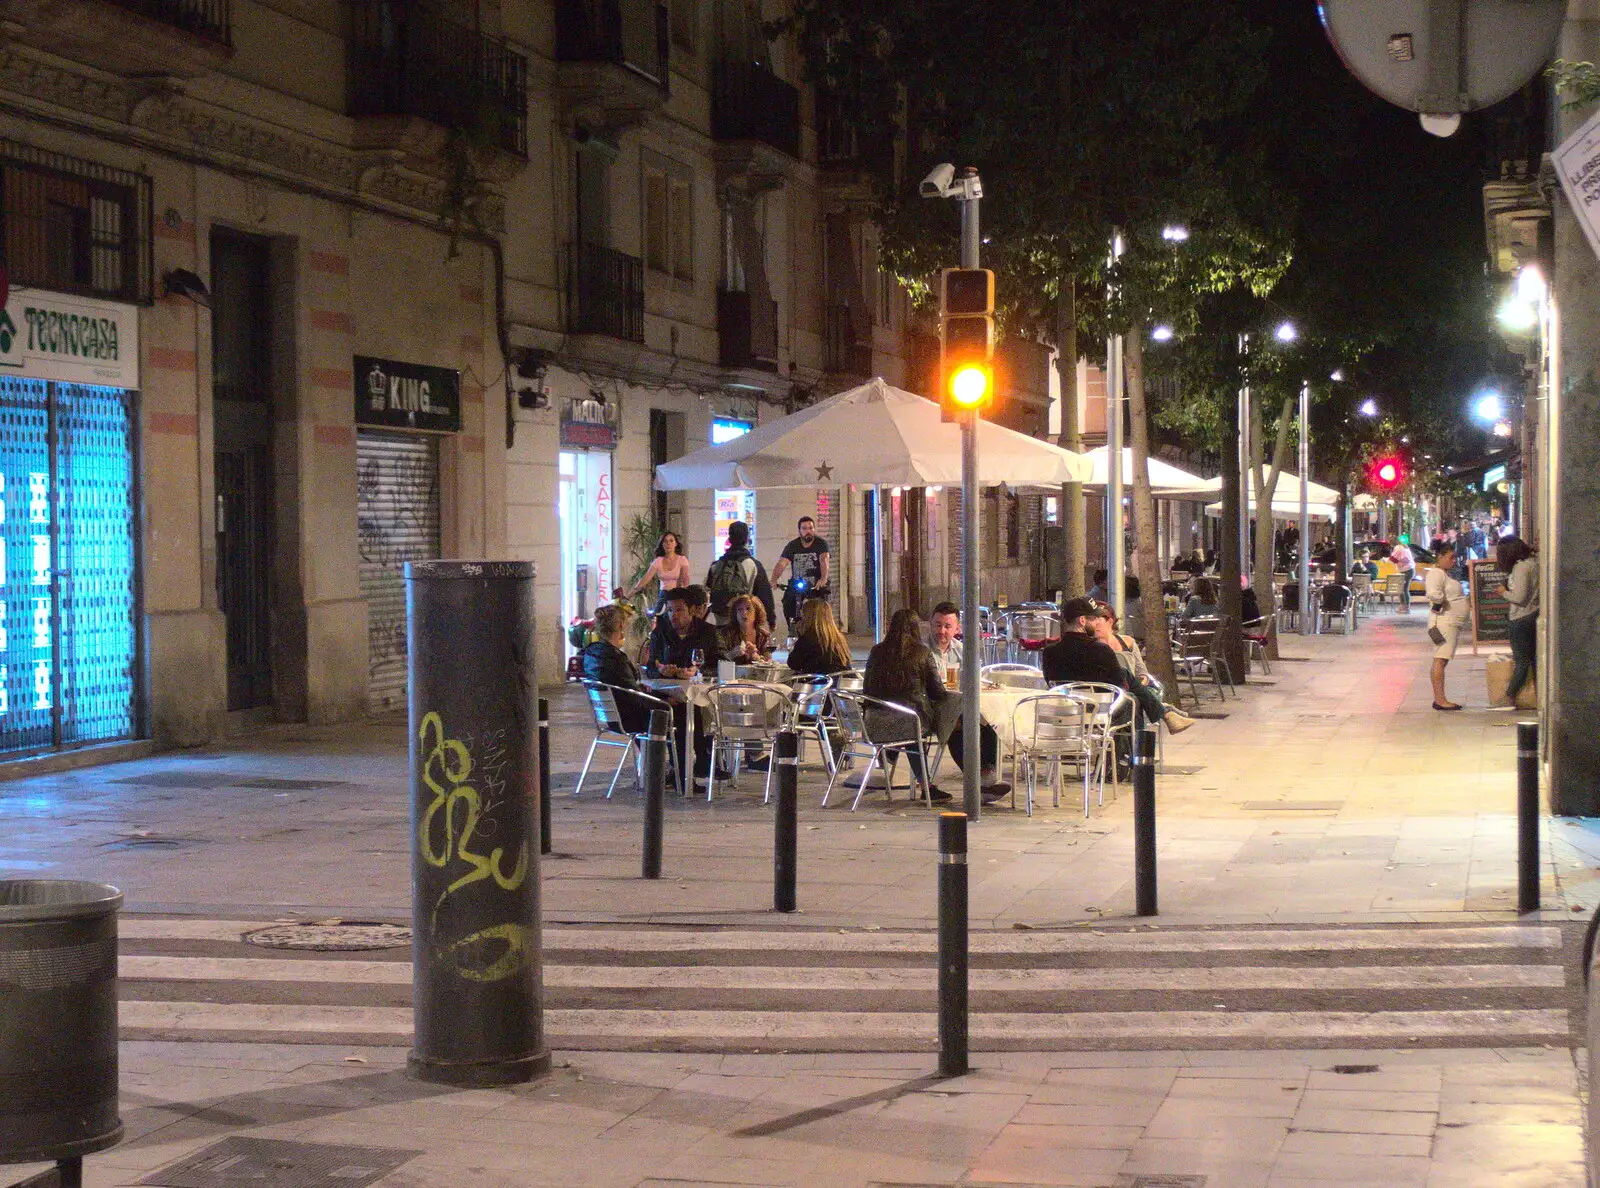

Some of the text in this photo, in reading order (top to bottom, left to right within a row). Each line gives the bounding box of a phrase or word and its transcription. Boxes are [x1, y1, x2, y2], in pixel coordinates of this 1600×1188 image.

[25, 307, 118, 360] TECNOCASA
[390, 375, 430, 413] KING
[597, 473, 610, 607] CARNICER
